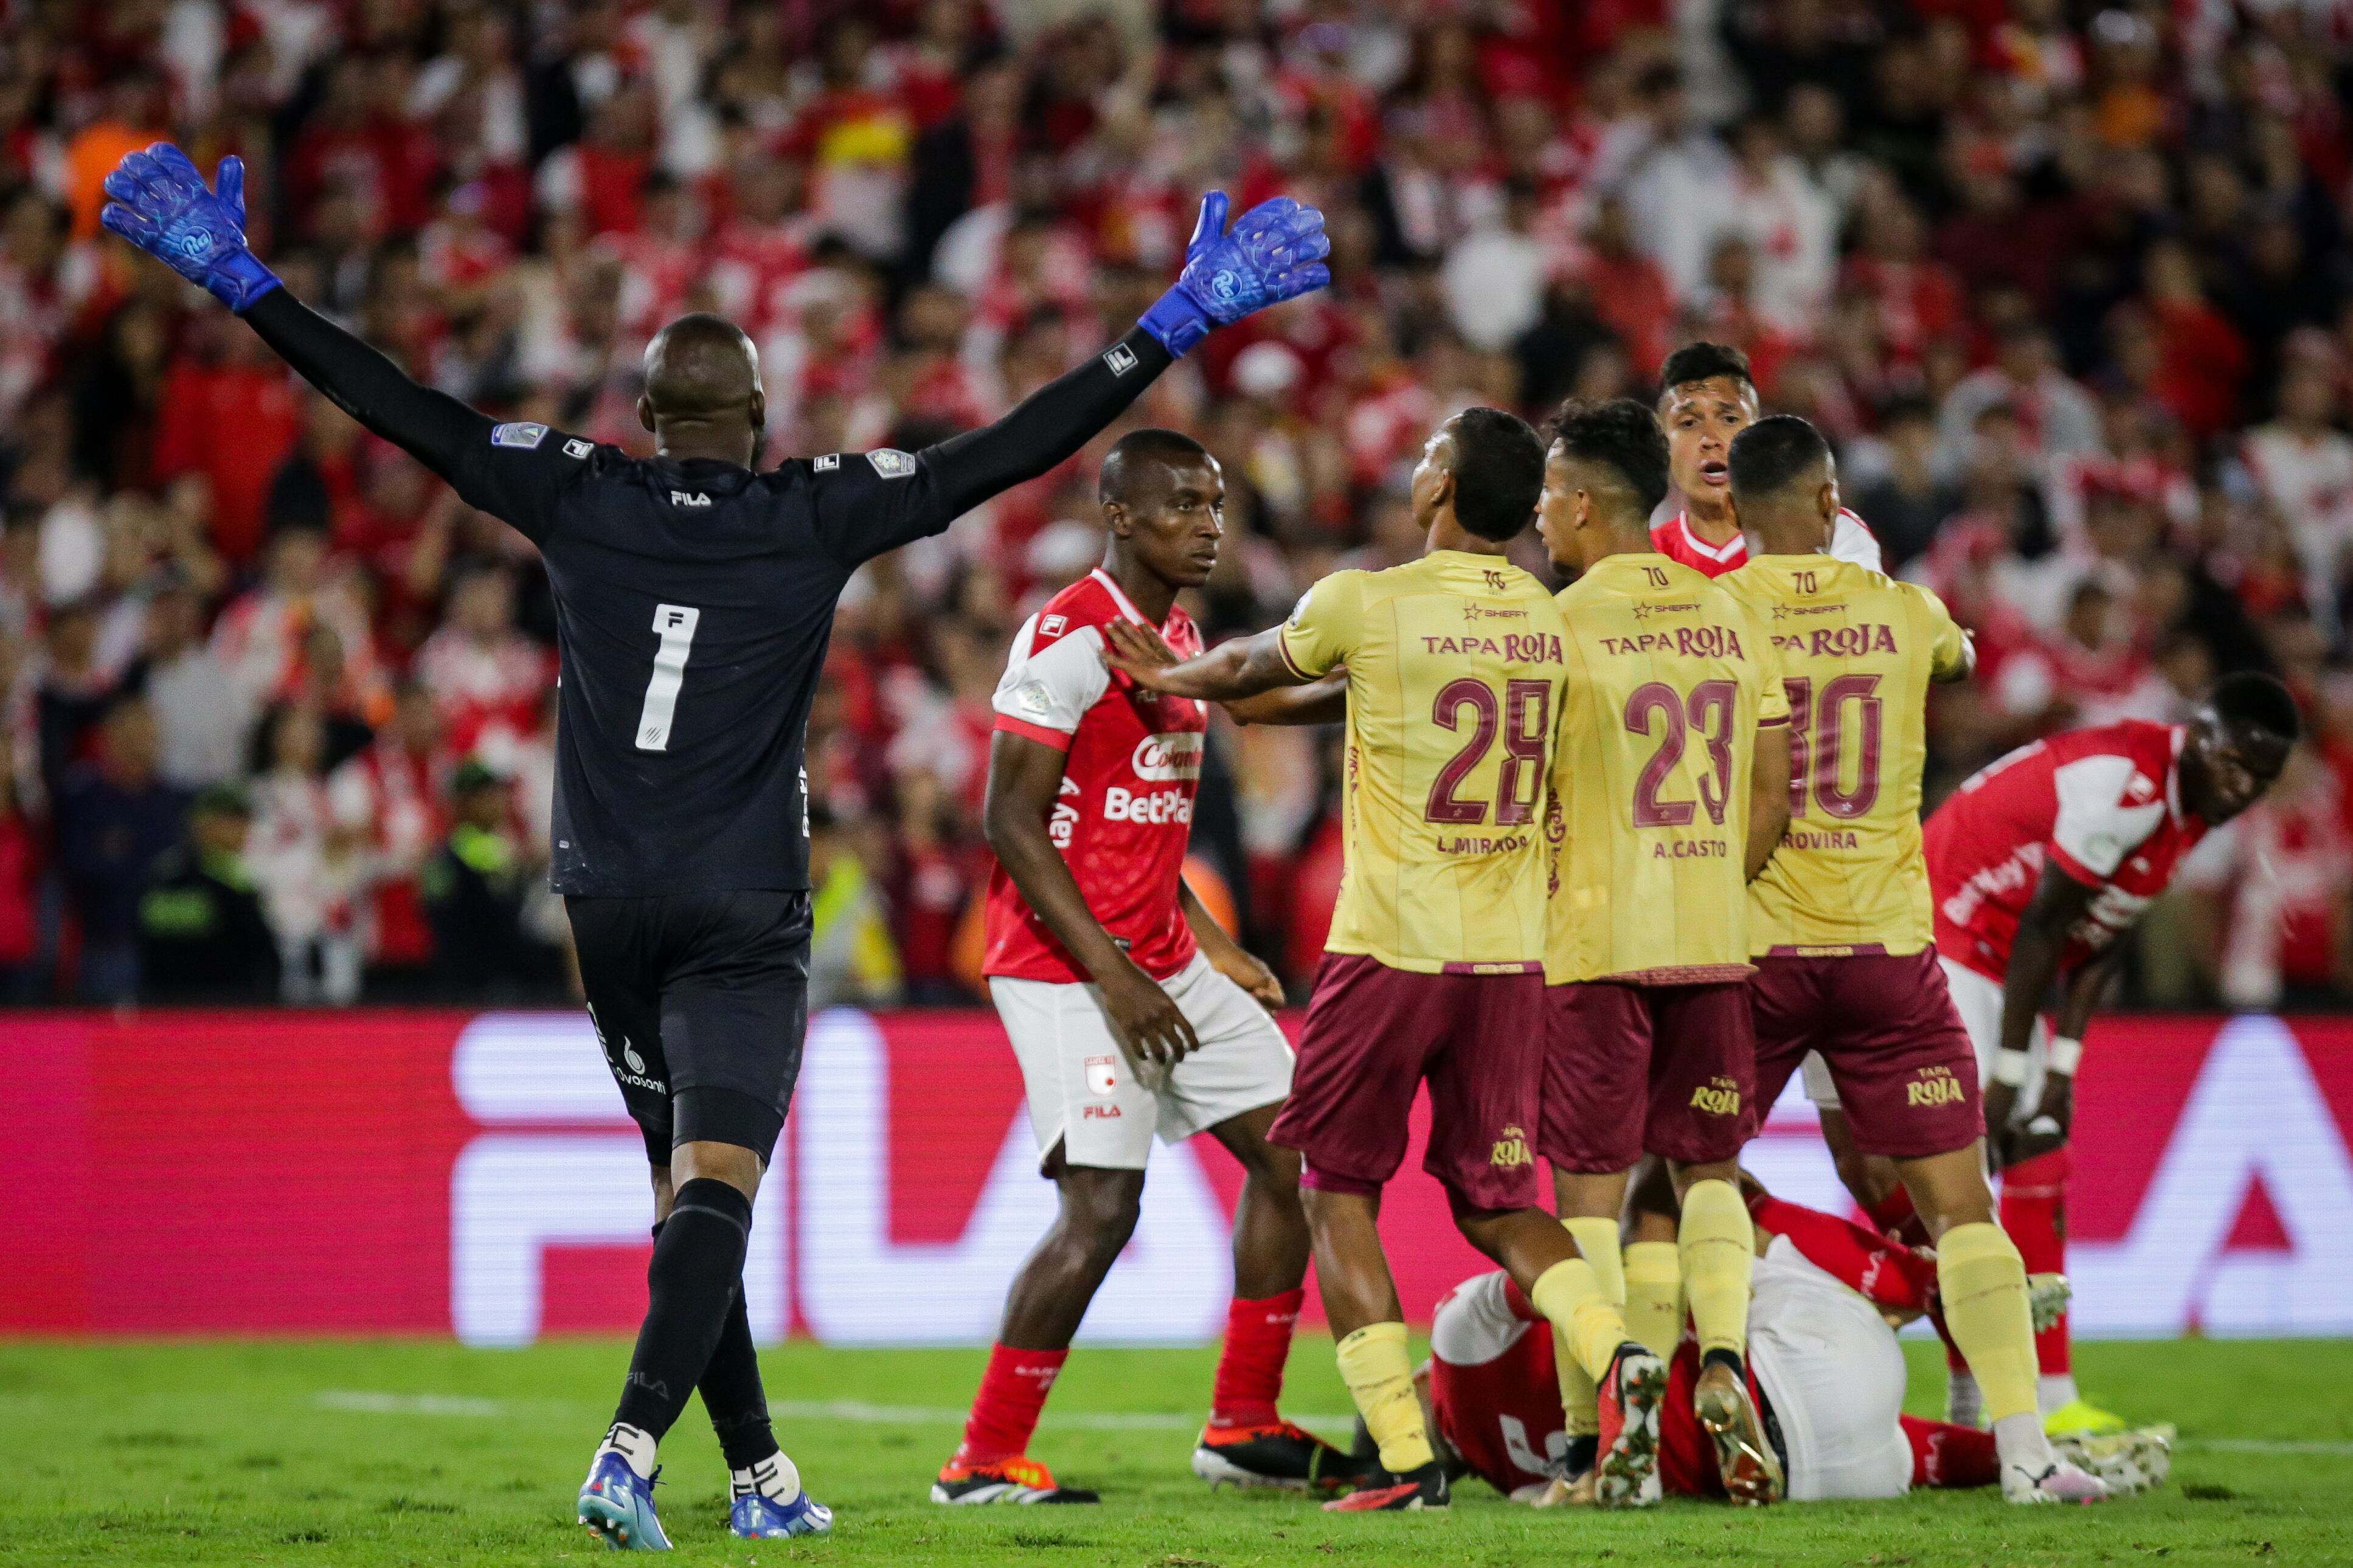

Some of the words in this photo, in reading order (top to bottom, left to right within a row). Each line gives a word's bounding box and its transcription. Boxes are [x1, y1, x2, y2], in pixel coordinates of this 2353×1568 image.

[671, 490, 711, 506] FILA
[1641, 567, 1669, 587] 70
[1791, 571, 1817, 593] 70
[1421, 637, 1501, 655] TAPA
[1503, 632, 1563, 665] ROJA
[1599, 632, 1674, 655] TAPA
[1675, 625, 1745, 661] ROJA
[1770, 634, 1806, 651] PA
[1810, 623, 1898, 657] ROJA
[636, 604, 699, 751] 1
[1424, 677, 1552, 826] 28
[1624, 680, 1738, 827] 23
[1783, 674, 1883, 819] 10
[1103, 786, 1196, 824] BetPla
[616, 1066, 666, 1095] Ovosanti
[1907, 1077, 1966, 1107] ROJA
[1083, 1105, 1121, 1119] FILA
